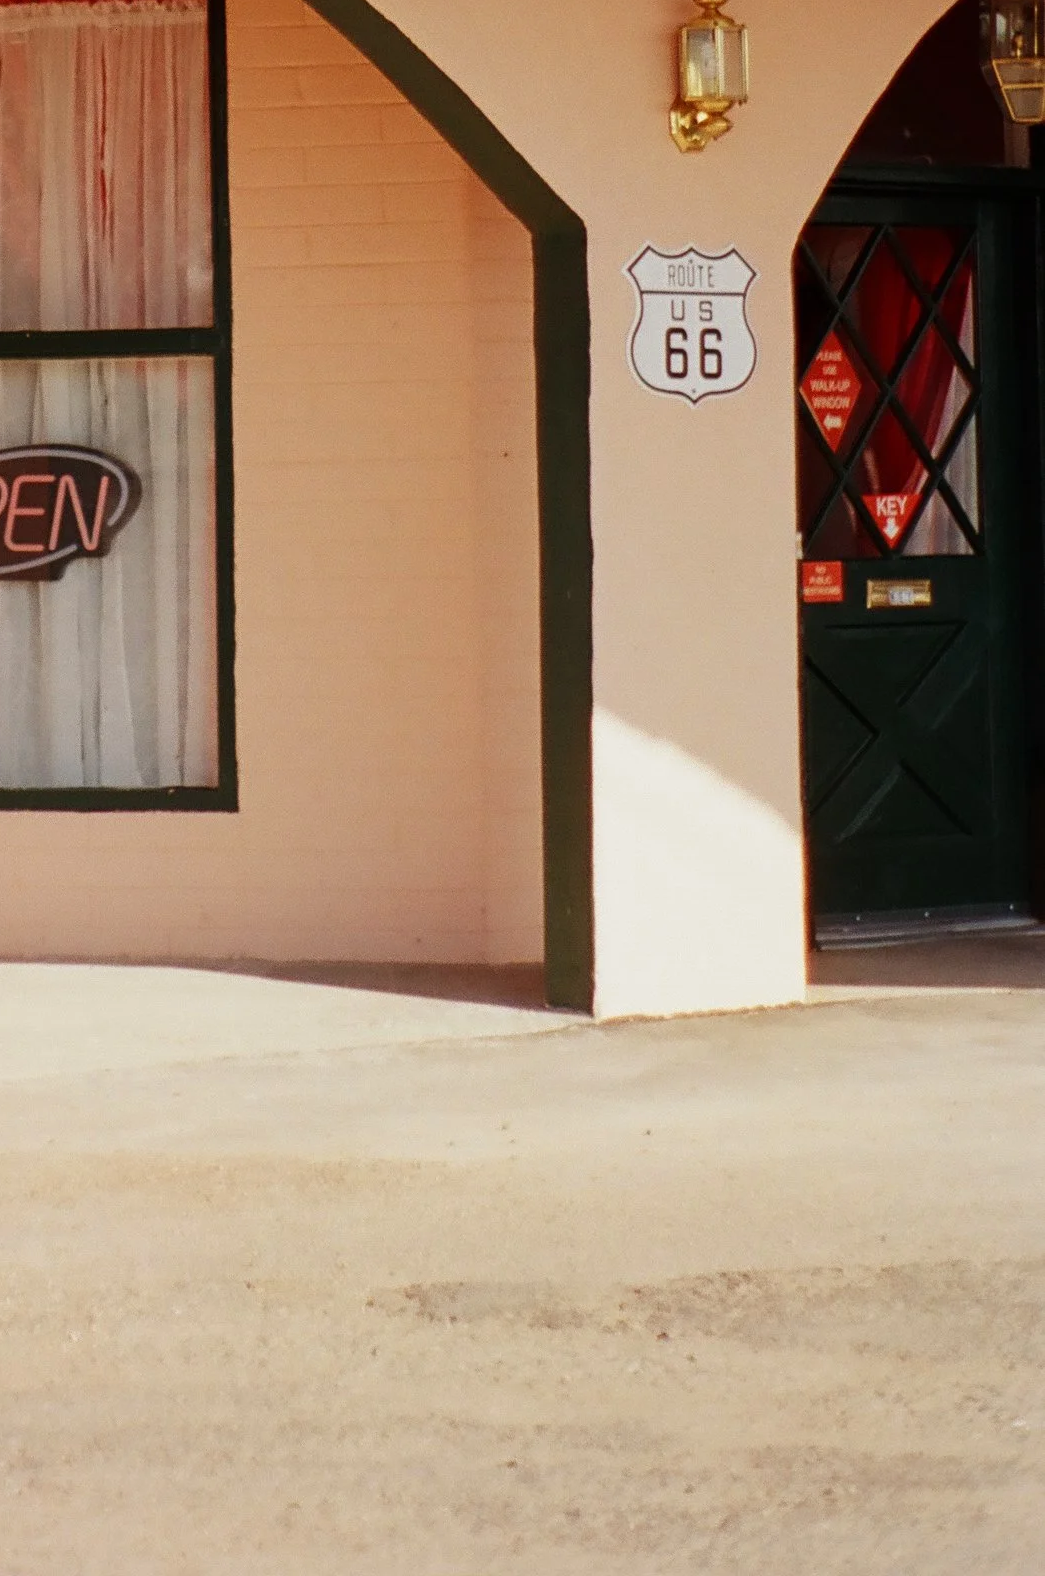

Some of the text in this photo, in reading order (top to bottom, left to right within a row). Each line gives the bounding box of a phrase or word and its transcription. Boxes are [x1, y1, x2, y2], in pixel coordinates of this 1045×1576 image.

[667, 264, 715, 288] ROUTE
[665, 327, 722, 379] 66
[876, 495, 908, 517] KEY
